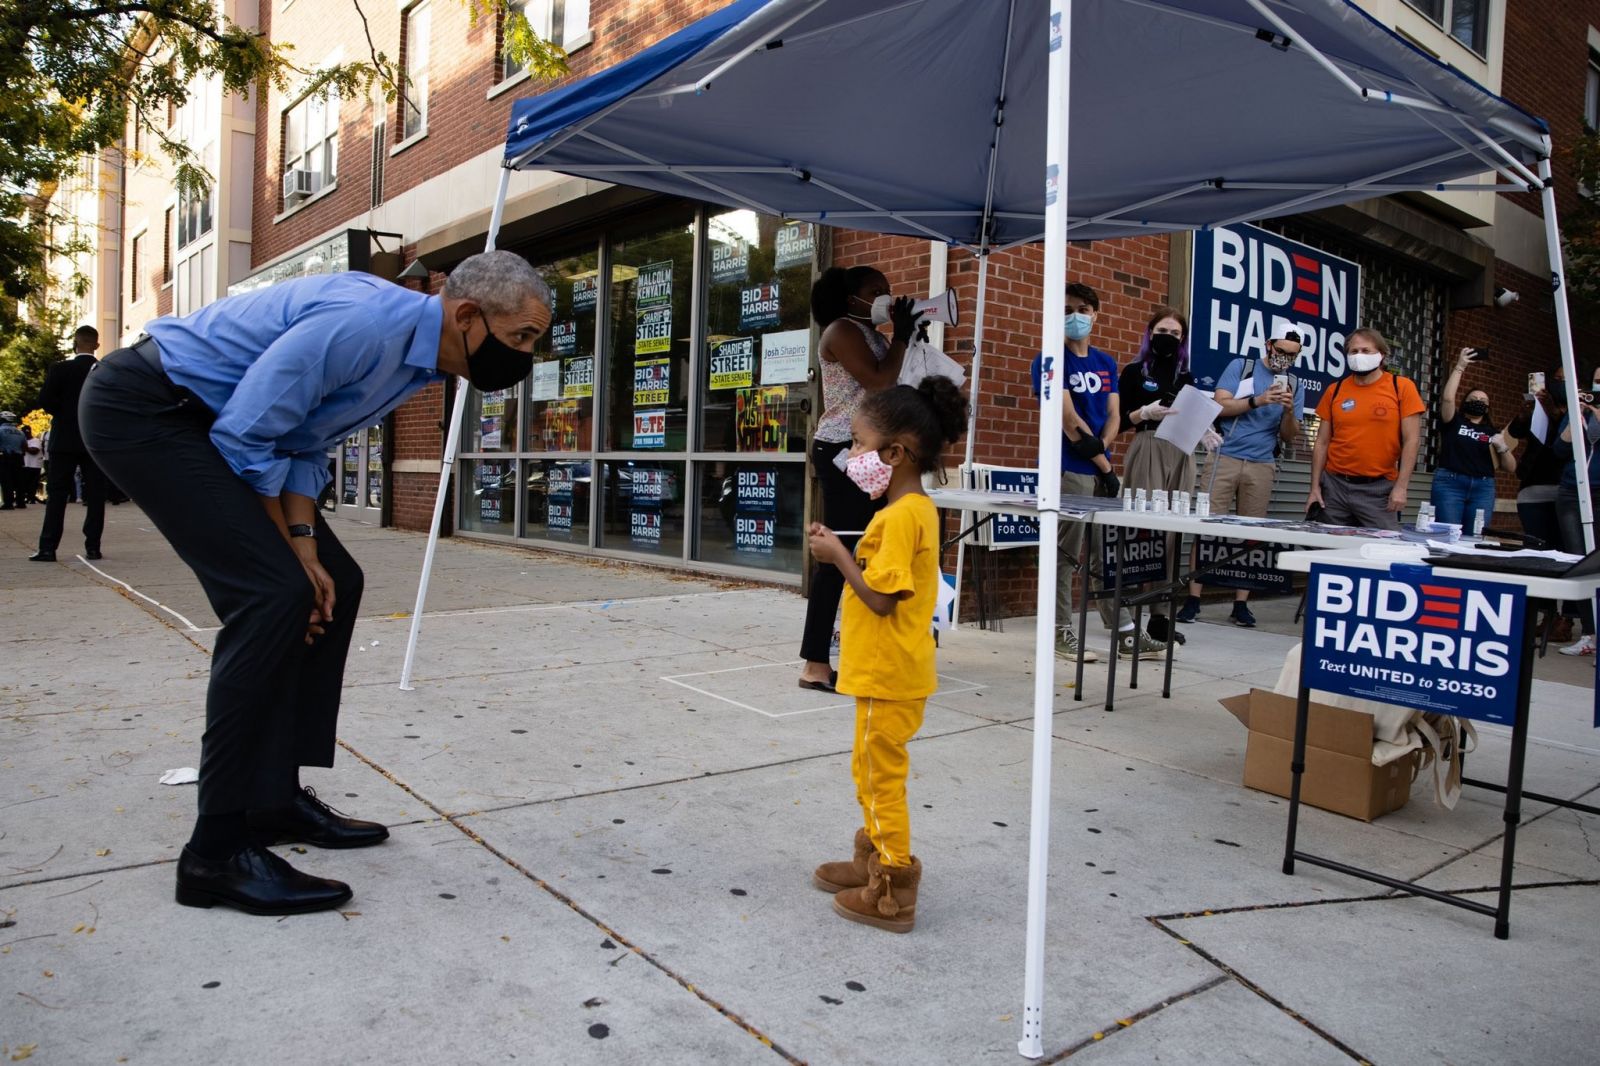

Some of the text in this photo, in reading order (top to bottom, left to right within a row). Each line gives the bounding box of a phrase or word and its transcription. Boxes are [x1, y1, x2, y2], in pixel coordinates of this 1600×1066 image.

[777, 223, 814, 243] BIDEN
[713, 240, 748, 261] BIDEN
[777, 238, 814, 256] HARRIS
[712, 256, 748, 273] HARRIS
[638, 268, 671, 288] MALCOLM
[1212, 227, 1346, 326] BIDEN
[573, 277, 598, 293] BIDEN
[637, 282, 671, 300] KENYATTA
[573, 290, 598, 302] HARRIS
[741, 284, 779, 304] BIDEN
[741, 300, 779, 316] HARRIS
[643, 311, 664, 324] SHARIF
[552, 322, 576, 336] BIDEN
[636, 322, 671, 340] STREET
[552, 334, 576, 346] HARRIS
[638, 339, 652, 349] STATE
[653, 337, 670, 346] SENATE
[1209, 298, 1346, 378] HARIS
[719, 342, 743, 357] SHARIF
[764, 345, 806, 360] Josh Shapiro
[711, 355, 752, 374] STREET
[565, 370, 593, 385] STREET
[635, 366, 669, 380] BIDEN
[714, 373, 731, 384] STATE
[731, 371, 752, 382] SENATE
[634, 380, 669, 391] HARRIS
[634, 392, 668, 403] STREET
[482, 406, 504, 415] STREET
[635, 415, 664, 433] VOTE
[482, 465, 501, 474] BIDEN
[549, 468, 573, 480] BIDEN
[482, 475, 501, 484] HARRIS
[633, 471, 662, 483] BIDEN
[738, 472, 775, 486] BIDEN
[549, 480, 573, 490] HARRIS
[632, 484, 662, 495] HARRIS
[737, 486, 775, 499] HARRIS
[481, 499, 500, 509] BIDEN
[548, 504, 572, 516] BIDEN
[481, 509, 500, 519] HARRIS
[631, 513, 660, 527] BIDEN
[548, 516, 572, 527] HARRIS
[737, 518, 774, 534] BIDEN
[631, 526, 660, 538] HARRIS
[998, 525, 1015, 534] FOR
[736, 533, 774, 546] HARRIS
[1199, 543, 1278, 569] HARRI
[1122, 565, 1140, 575] NITED
[1145, 562, 1162, 571] 30330
[1215, 568, 1247, 578] UNITED
[1257, 572, 1284, 582] 30330
[1316, 572, 1514, 637] BIDEN
[1315, 616, 1510, 677] HARRIS
[1319, 659, 1346, 674] Text
[1349, 664, 1415, 686] UNITED
[1419, 677, 1433, 689] to
[1437, 678, 1497, 700] 30330
